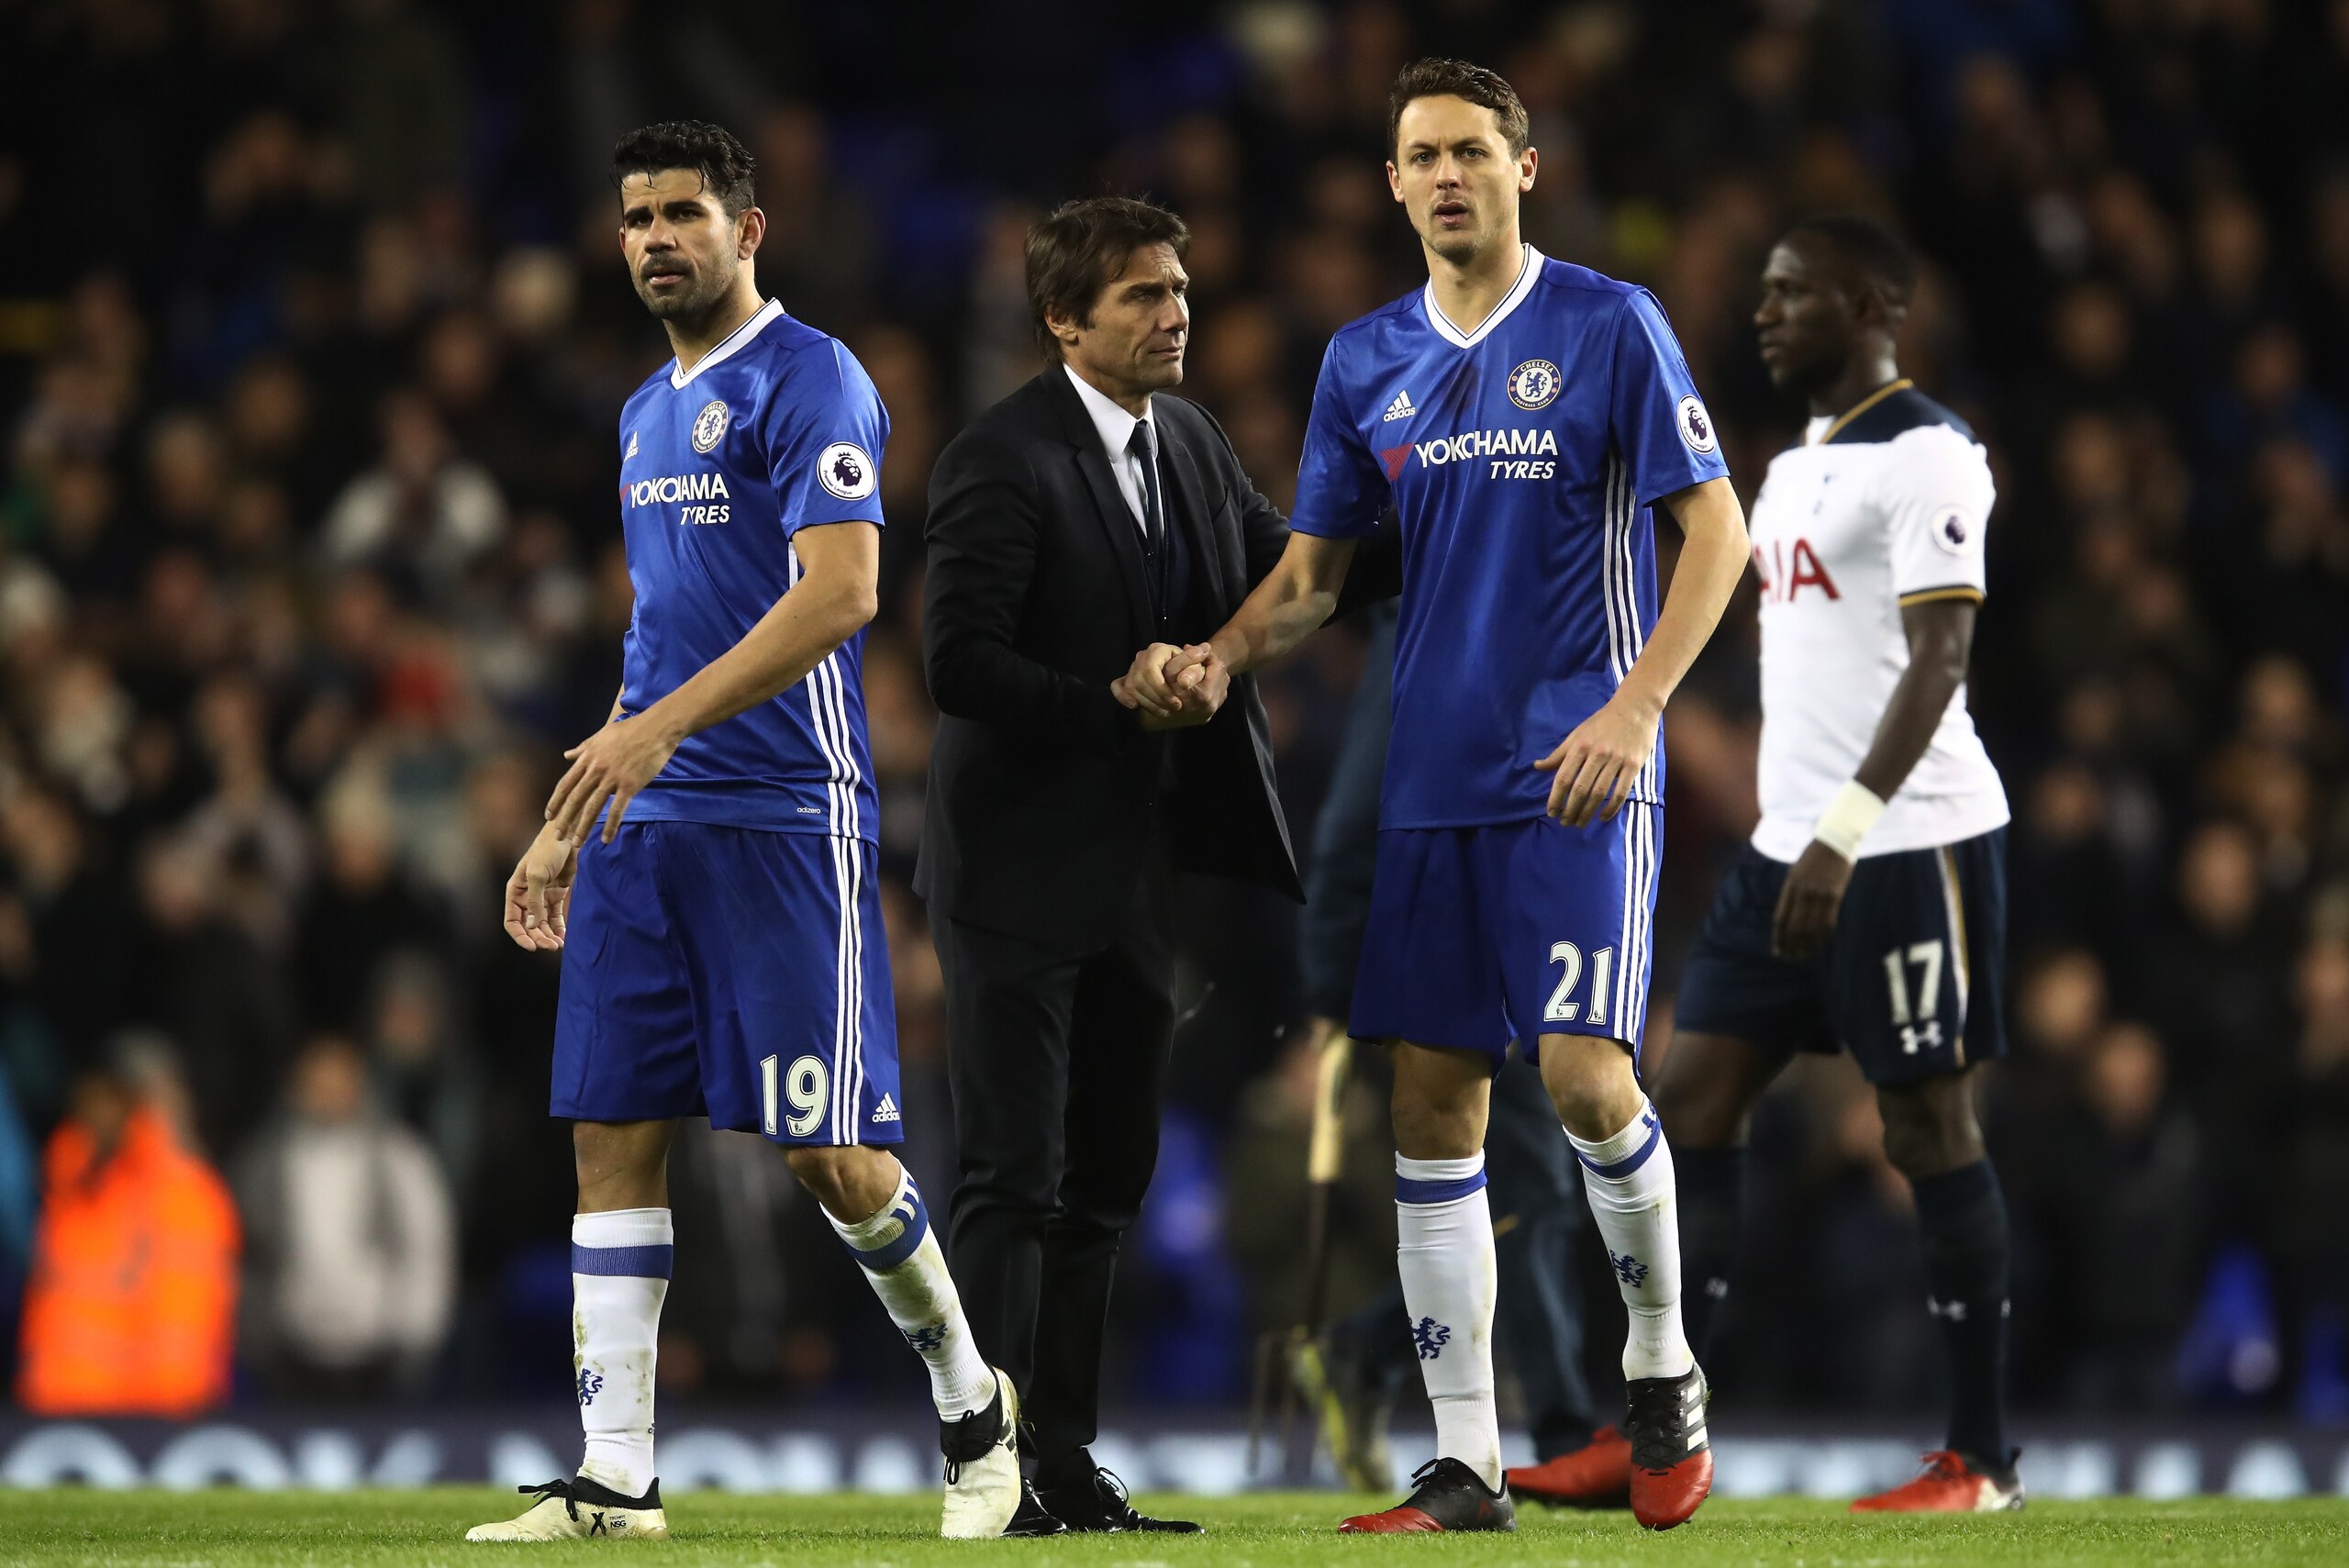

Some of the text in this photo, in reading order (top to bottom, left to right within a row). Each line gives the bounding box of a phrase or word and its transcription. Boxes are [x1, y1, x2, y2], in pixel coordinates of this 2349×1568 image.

[1520, 361, 1554, 373] CHELSEA
[704, 403, 726, 415] CHELSEA
[1383, 406, 1417, 422] adidas
[1414, 428, 1559, 469] YOKOHAMA
[1490, 461, 1557, 480] TYRES
[680, 505, 730, 526] TYRES
[1543, 940, 1612, 1026] 21
[1882, 939, 1944, 1026] 17
[760, 1054, 829, 1137] 19
[872, 1110, 901, 1123] adidas
